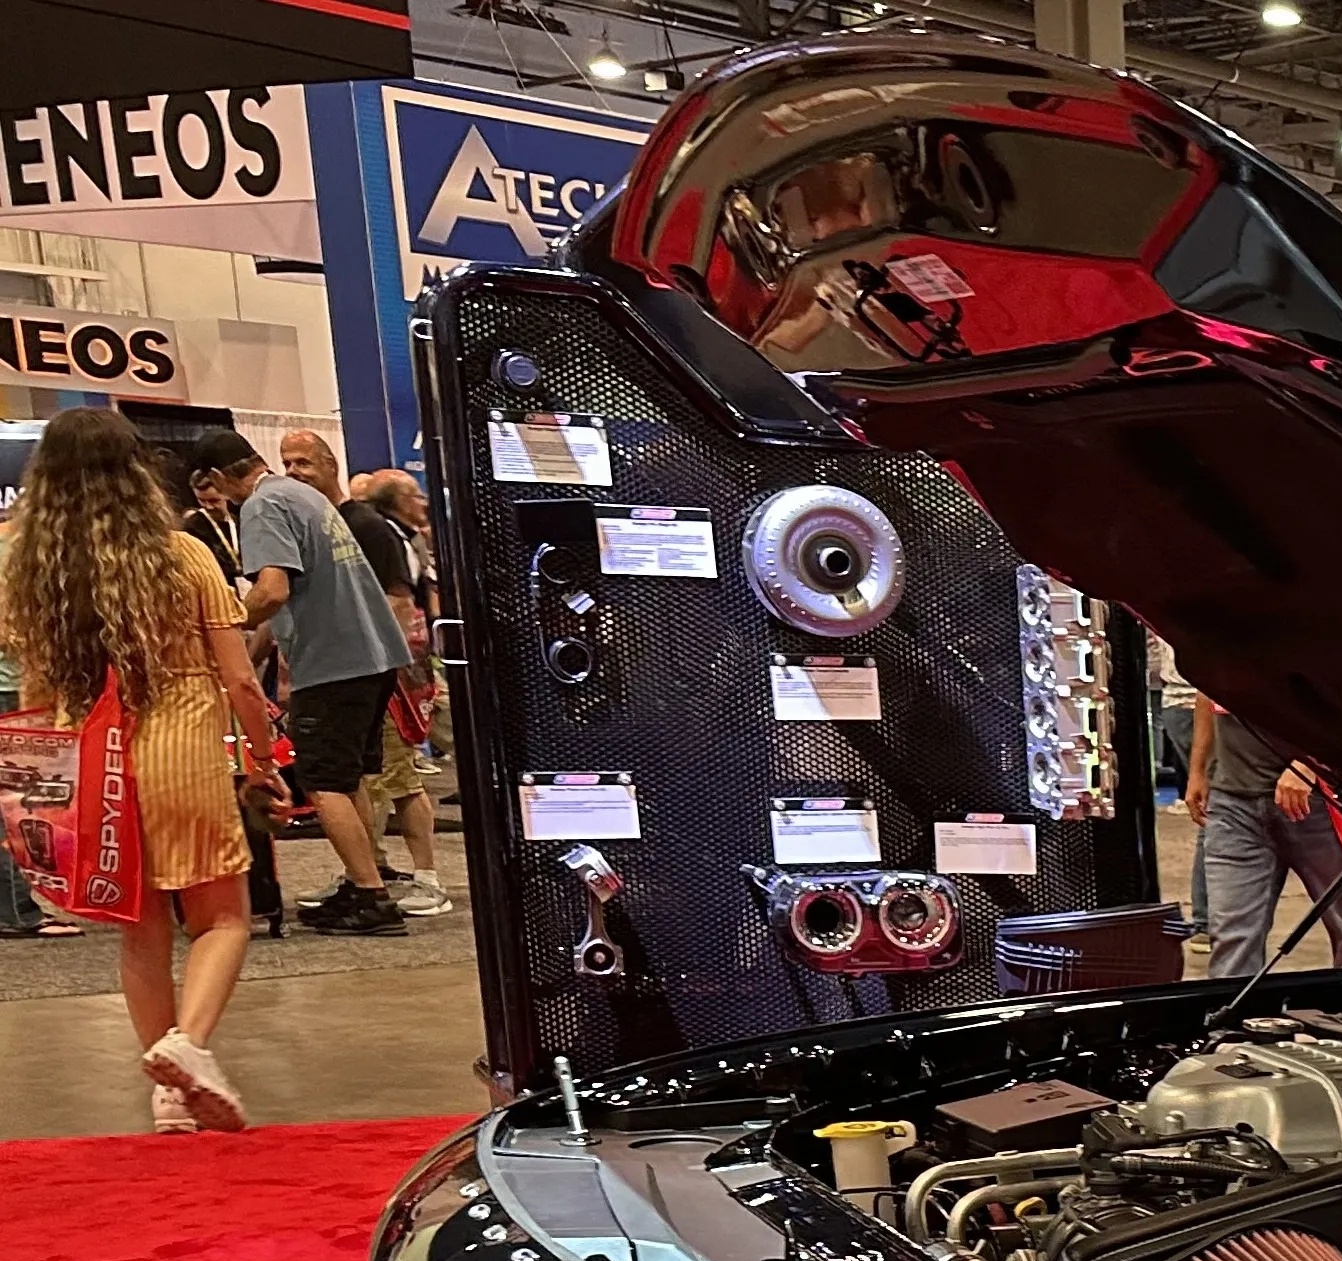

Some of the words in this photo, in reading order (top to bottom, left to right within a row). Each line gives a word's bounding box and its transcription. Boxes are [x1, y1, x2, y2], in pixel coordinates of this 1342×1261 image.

[1, 87, 281, 206] ENEOS
[418, 124, 606, 257] ATEC
[99, 727, 124, 873] SPYDER
